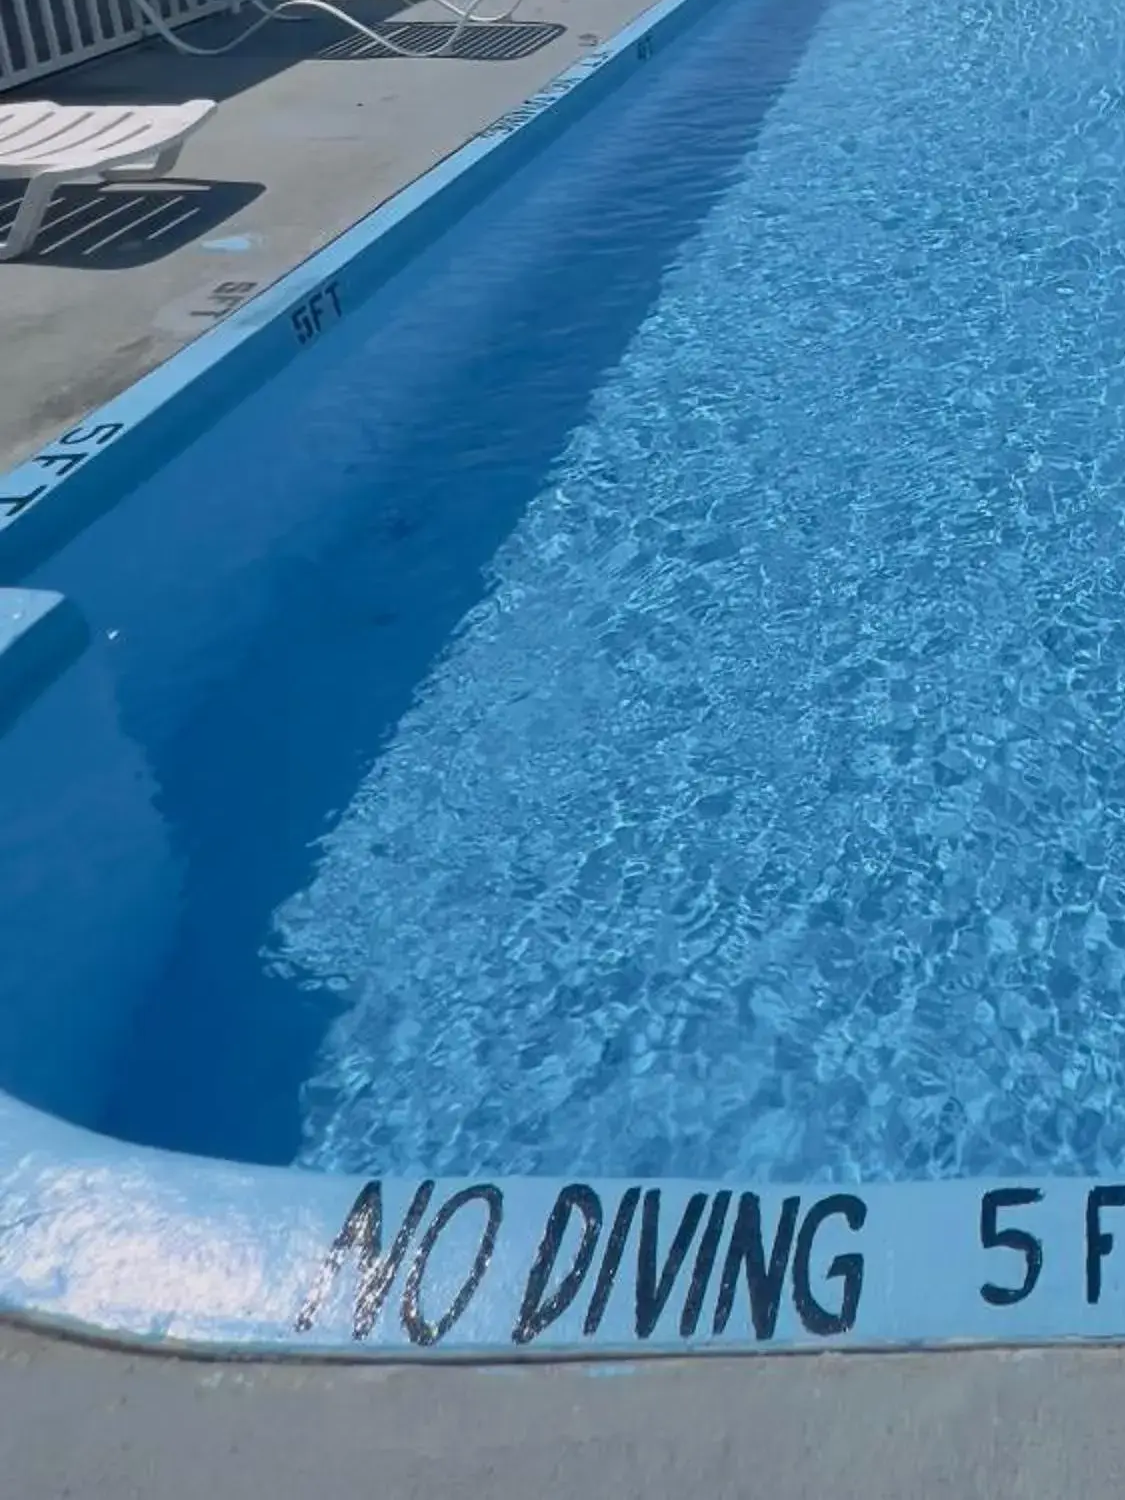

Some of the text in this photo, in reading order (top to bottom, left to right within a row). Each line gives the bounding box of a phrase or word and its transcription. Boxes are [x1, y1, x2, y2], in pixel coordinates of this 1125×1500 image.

[190, 282, 257, 318] 5FT
[292, 282, 342, 345] 5FT
[0, 423, 124, 517] 5FT
[296, 1179, 504, 1346] NO
[512, 1182, 868, 1345] DIVING
